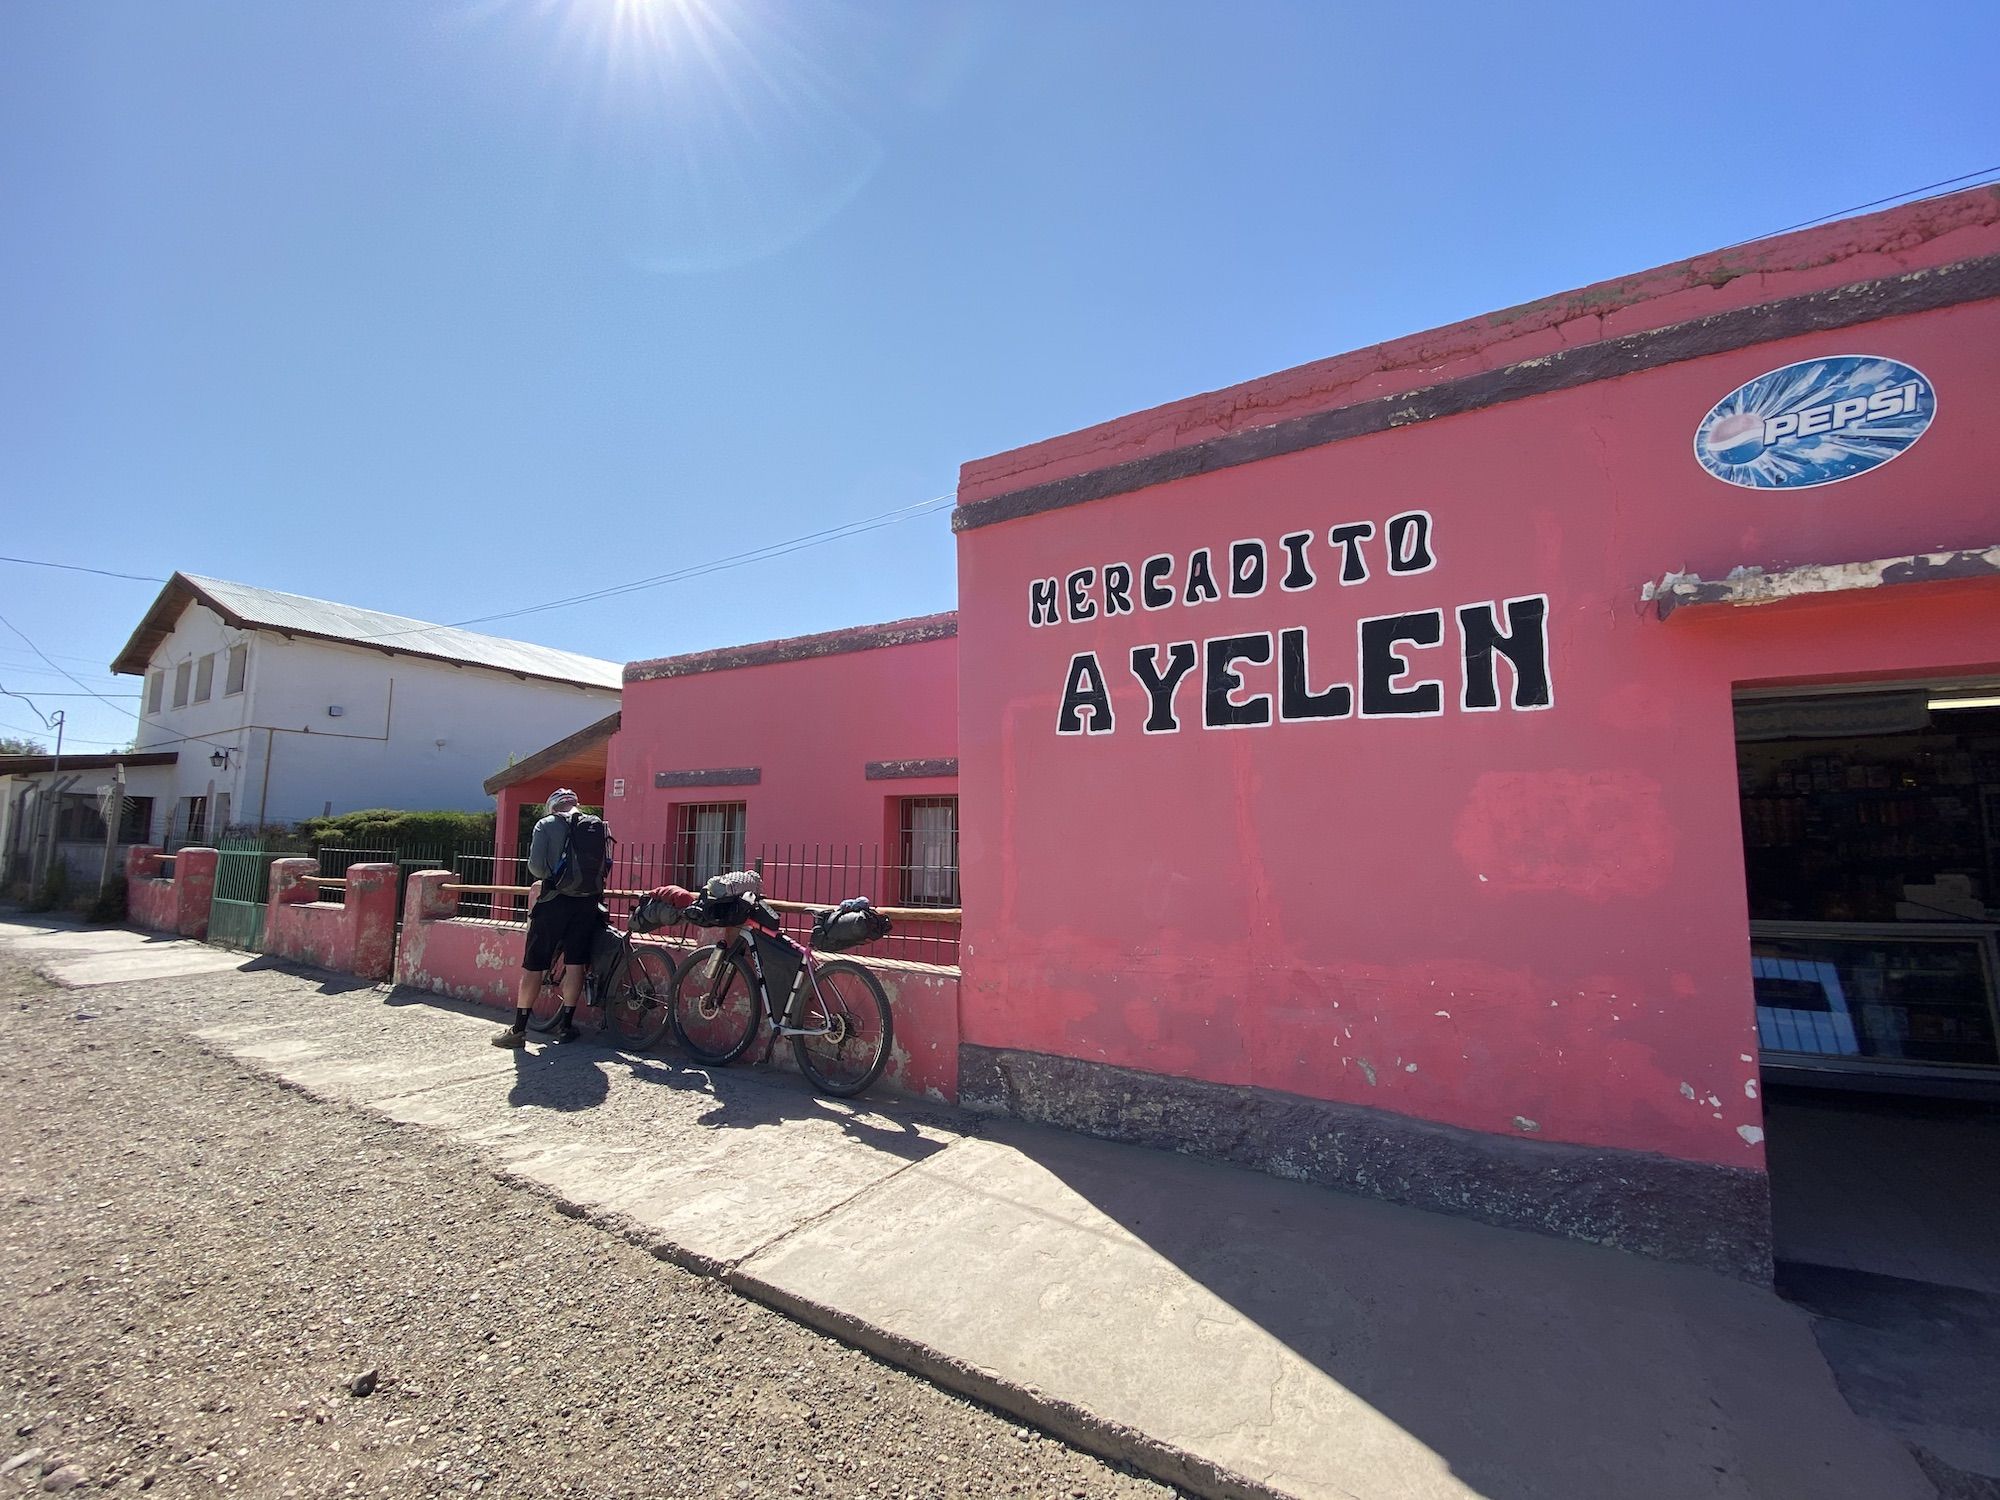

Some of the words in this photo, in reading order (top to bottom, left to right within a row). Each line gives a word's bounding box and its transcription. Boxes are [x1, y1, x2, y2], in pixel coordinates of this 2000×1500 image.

[1763, 383, 1917, 446] PEPSI
[1029, 509, 1437, 628] MERCADITO
[1056, 593, 1554, 736] AYELEN
